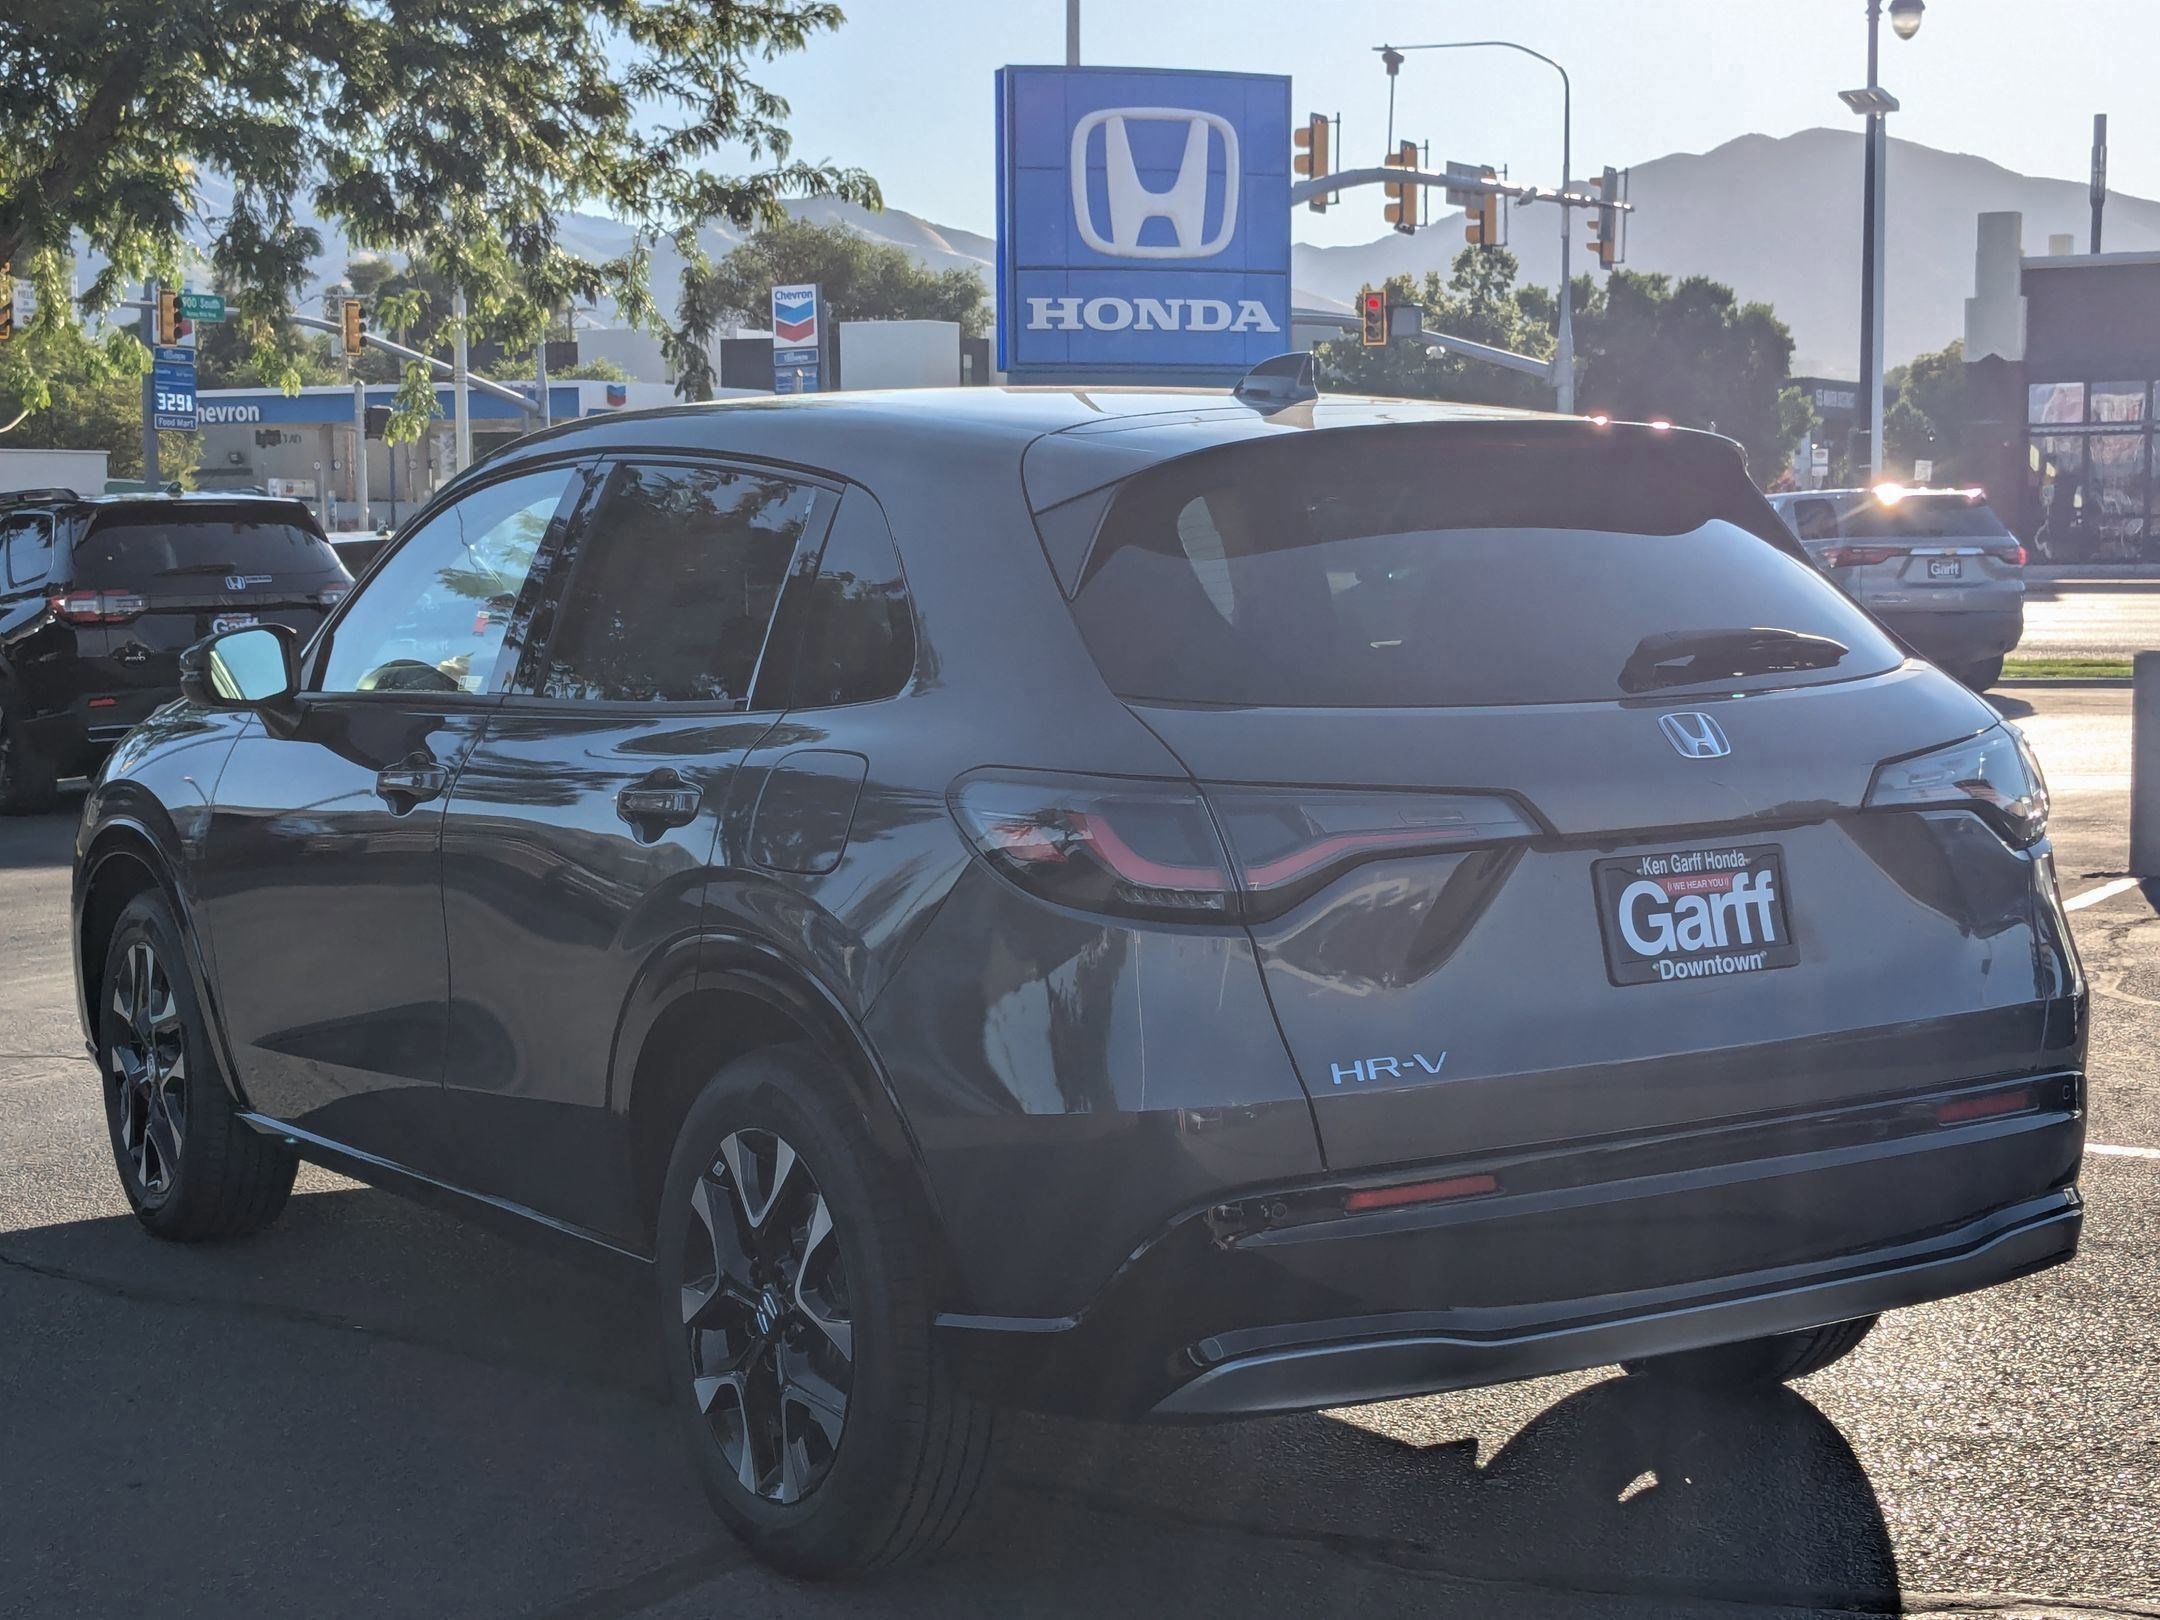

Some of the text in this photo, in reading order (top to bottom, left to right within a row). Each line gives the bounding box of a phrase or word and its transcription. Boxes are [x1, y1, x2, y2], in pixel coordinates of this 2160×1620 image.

[774, 291, 814, 301] Chevron
[1026, 297, 1281, 333] HONDA
[158, 418, 195, 429] Food Mart
[196, 404, 260, 423] hevron
[1641, 849, 1746, 876] Ken Garff Honda
[1671, 877, 1725, 891] WE HEAR YOU
[1618, 870, 1776, 957] Garff
[1659, 953, 1763, 981] Downtown
[1330, 1051, 1447, 1085] HR-V
